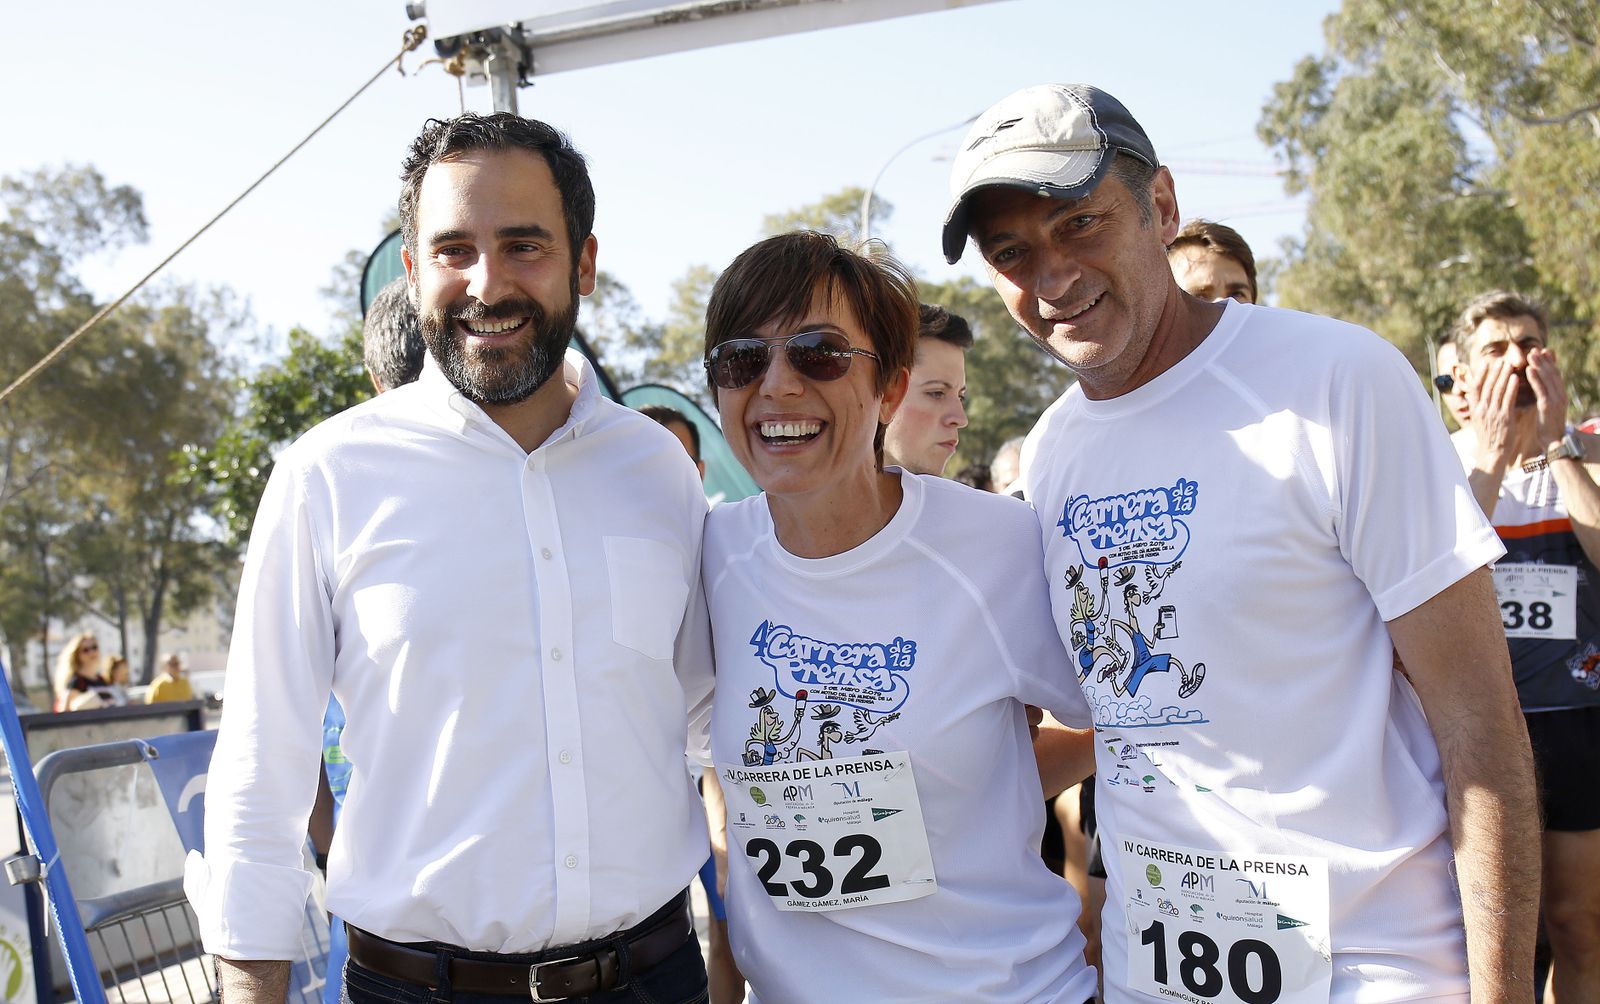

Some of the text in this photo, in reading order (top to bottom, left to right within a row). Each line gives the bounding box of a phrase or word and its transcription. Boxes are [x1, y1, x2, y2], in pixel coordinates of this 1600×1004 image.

[1172, 483, 1195, 497] de
[1072, 490, 1169, 532] Carrera
[1172, 497, 1193, 512] la
[1082, 514, 1174, 548] Prensa
[1501, 601, 1553, 630] 38
[768, 632, 887, 668] Carrera
[889, 641, 911, 654] de
[890, 654, 911, 668] la
[785, 660, 892, 691] Prensa
[737, 771, 790, 782] CARRERA
[793, 768, 811, 780] DE
[814, 766, 833, 778] LA
[836, 759, 894, 776] PRENSA
[783, 784, 814, 801] APM
[745, 833, 890, 899] 232
[1124, 841, 1309, 876] IV CARRERA DE LA PRENSA
[1181, 871, 1214, 893] APM
[843, 895, 869, 904] MARÍA
[1141, 919, 1282, 1004] 180
